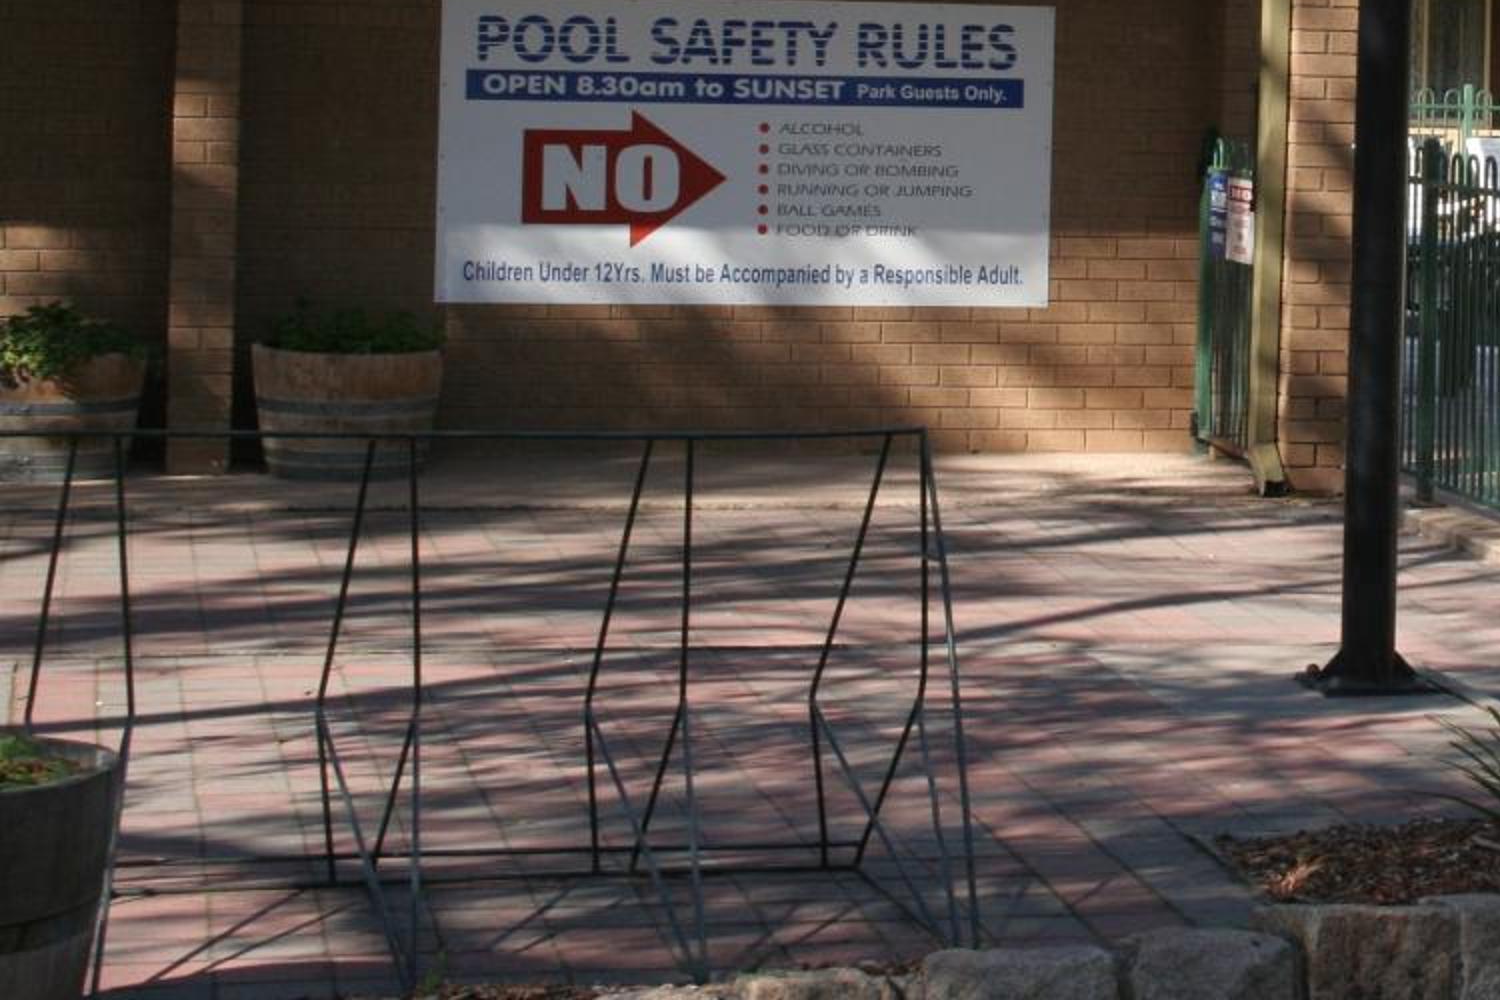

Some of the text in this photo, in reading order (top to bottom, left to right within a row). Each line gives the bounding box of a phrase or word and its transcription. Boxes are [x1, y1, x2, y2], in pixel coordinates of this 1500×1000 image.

[478, 15, 1018, 71] POOL SAFETY RULES
[483, 73, 1007, 104] OPEN 8.30am to SUNSET Park Guests Only.
[779, 123, 865, 136] ALCOHOL
[778, 143, 942, 158] GLASS CONTAINERS
[540, 143, 681, 213] NO
[777, 163, 959, 178] DIVING OR BOMBING
[777, 183, 973, 198] RUNNING OR JUMPING
[777, 204, 881, 217] BALL GAMES
[777, 223, 918, 237] FOOD OR DRINK
[463, 260, 1025, 289] Children Under 12Yrs. Must be Accompanied by a Responsible Adult.
